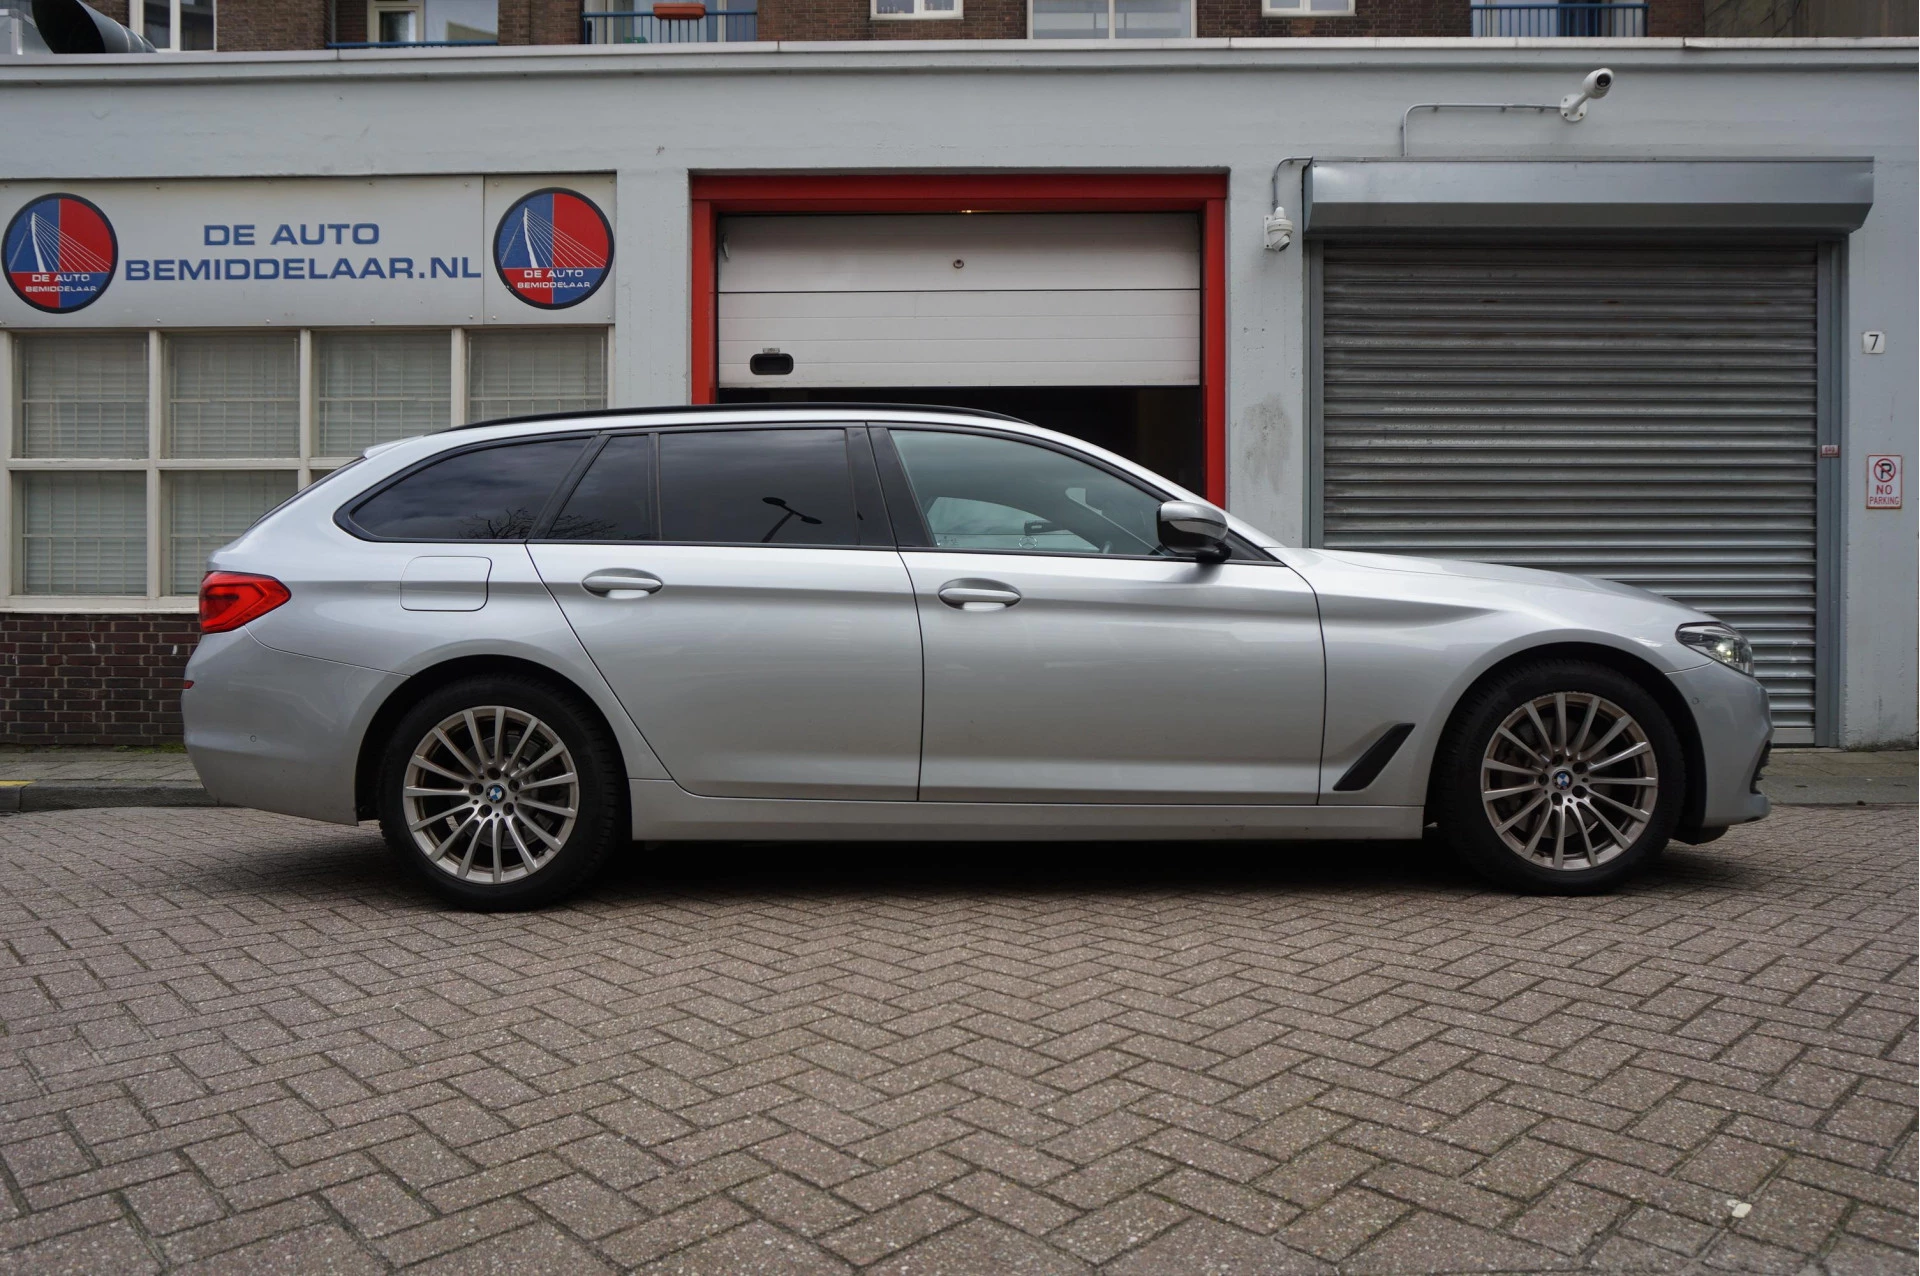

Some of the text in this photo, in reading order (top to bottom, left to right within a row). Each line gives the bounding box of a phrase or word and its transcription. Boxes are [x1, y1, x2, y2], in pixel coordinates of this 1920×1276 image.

[203, 223, 380, 246] DE AUTO
[125, 257, 482, 281] BEMIDDELAAR.NL
[523, 269, 584, 278] DE AUTO
[31, 273, 90, 282] DE AUTO
[517, 281, 591, 289] BEMIDDELAAR
[1868, 334, 1879, 350] 7
[1876, 484, 1893, 495] NO
[1869, 496, 1900, 505] PARKING
